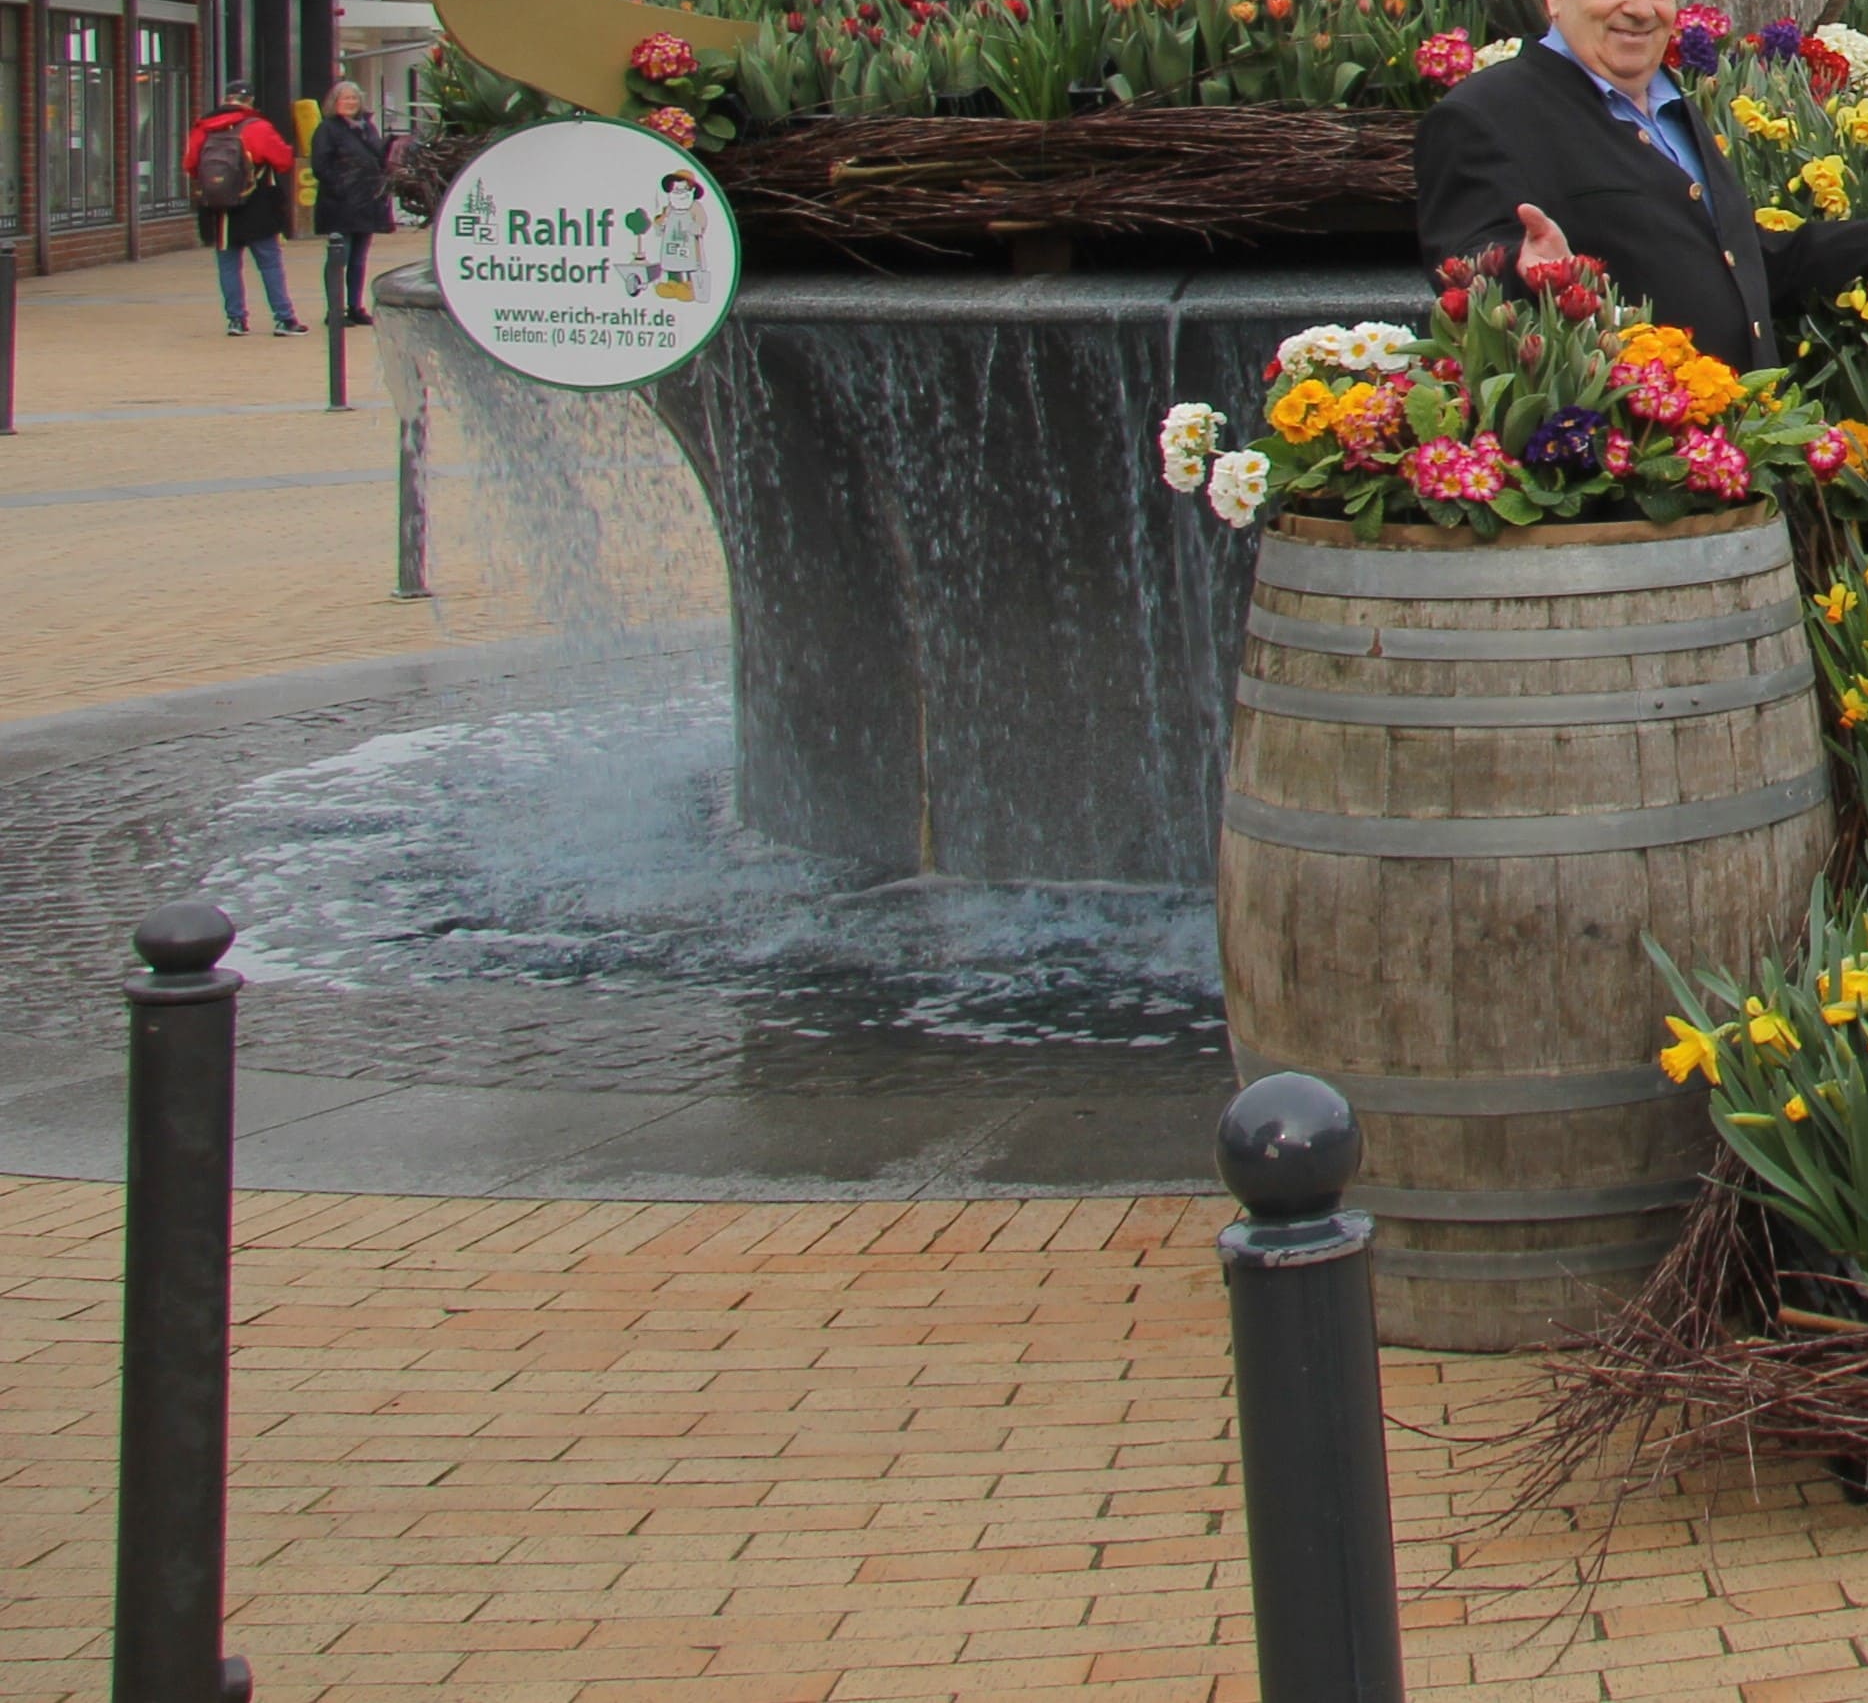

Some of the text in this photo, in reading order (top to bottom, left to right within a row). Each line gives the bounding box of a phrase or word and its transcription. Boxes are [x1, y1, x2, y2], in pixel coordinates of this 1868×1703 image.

[508, 208, 615, 247] Rahlf
[459, 254, 610, 284] Schürsdorf
[494, 307, 676, 327] www.erich-rahlf.de
[494, 325, 548, 344] Telefon:
[569, 329, 586, 346] 45
[590, 329, 613, 348] 24)
[616, 330, 634, 347] 70
[637, 331, 655, 348] 67
[658, 331, 676, 348] 20
